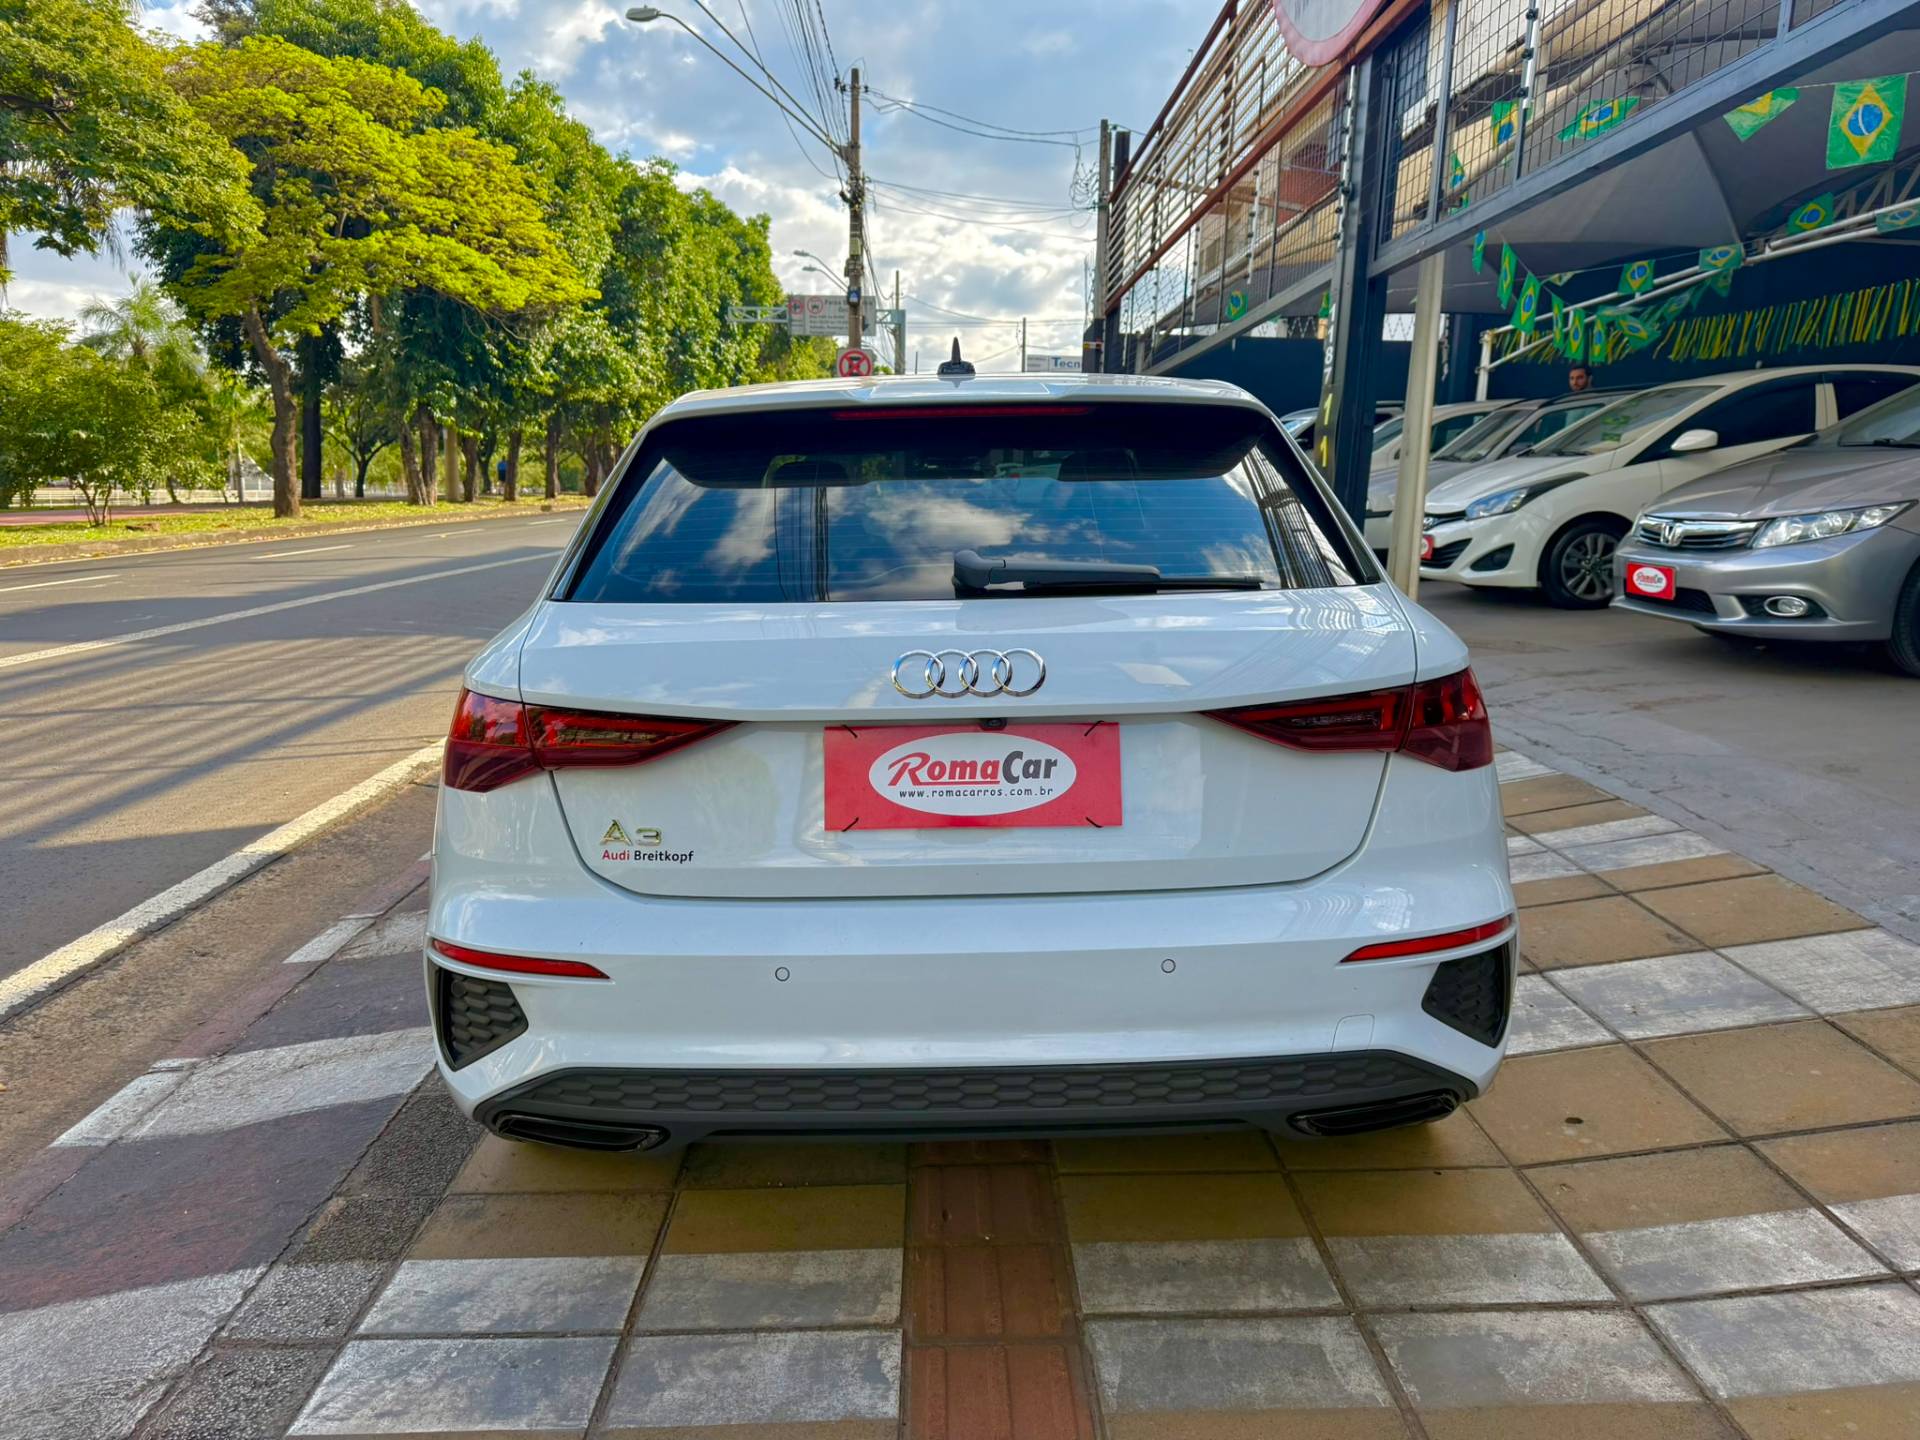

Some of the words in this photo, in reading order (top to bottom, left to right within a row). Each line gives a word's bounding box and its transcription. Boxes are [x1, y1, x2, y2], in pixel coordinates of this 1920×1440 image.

[887, 750, 1058, 787] RomaCar
[899, 786, 1053, 798] www.romacarros.com.br
[600, 818, 662, 847] A3
[602, 849, 630, 861] Audi
[634, 850, 694, 864] Breitkopf
